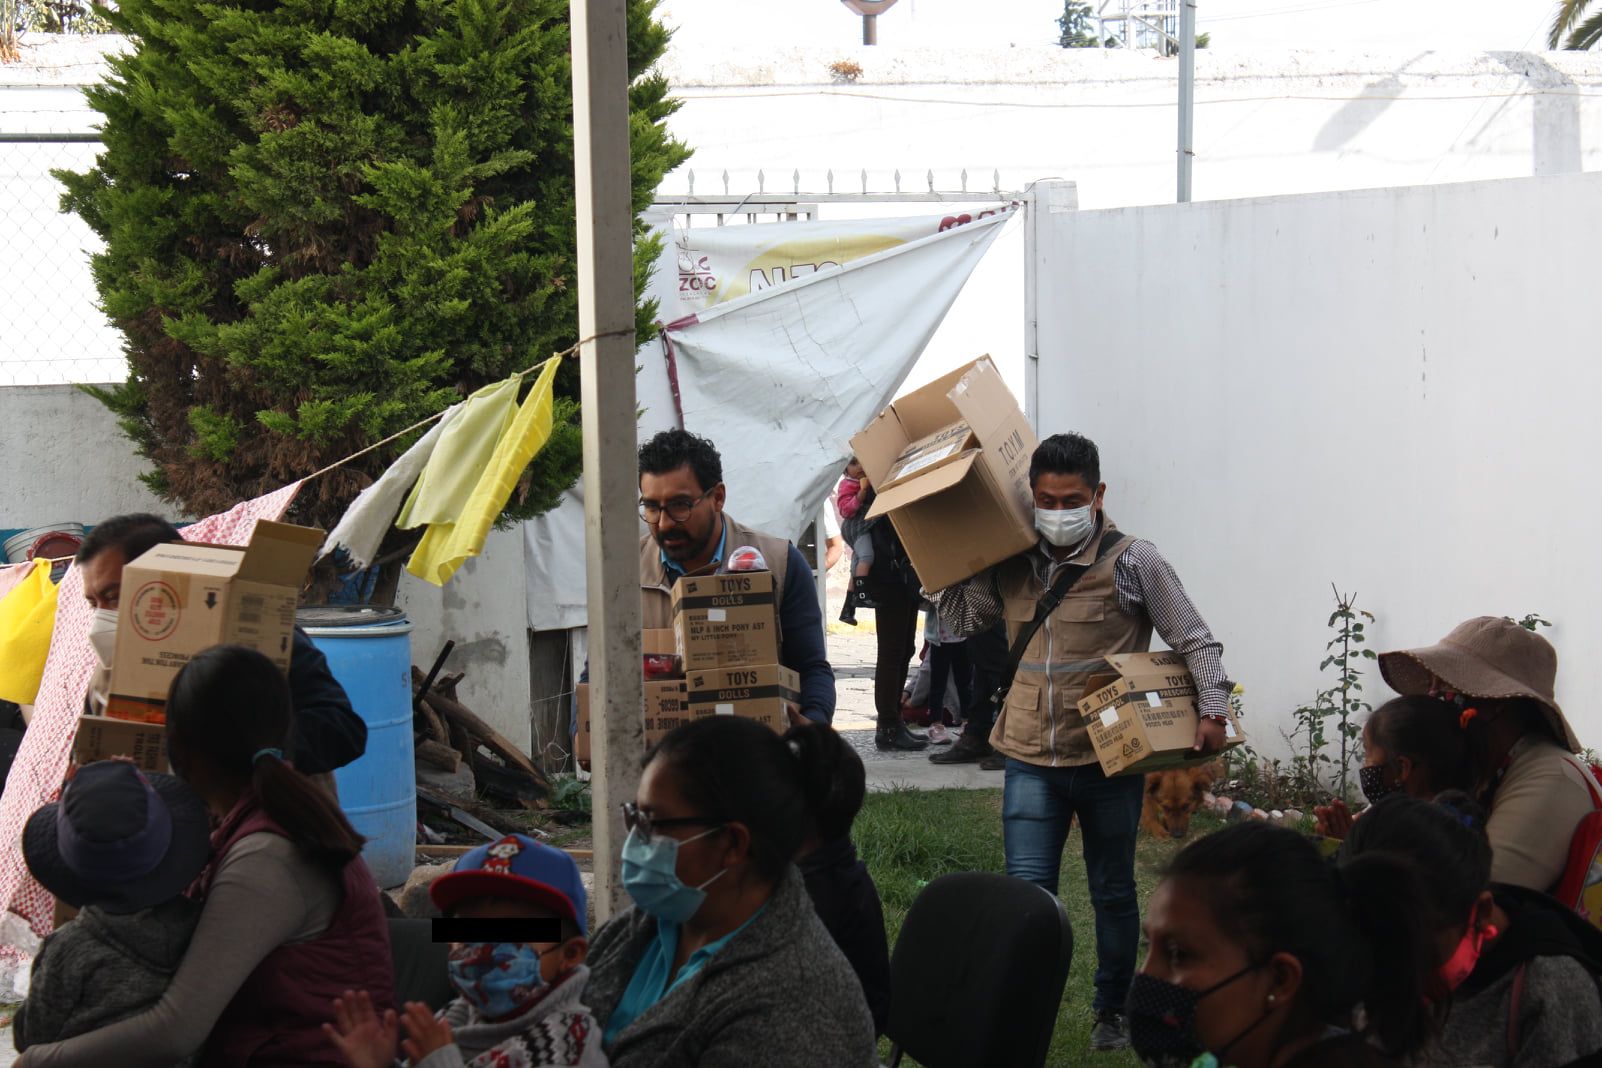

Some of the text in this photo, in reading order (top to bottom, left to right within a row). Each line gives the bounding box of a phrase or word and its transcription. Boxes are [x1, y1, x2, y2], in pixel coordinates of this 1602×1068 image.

[720, 577, 751, 593] TOYS
[712, 596, 744, 606] DOLLS
[727, 671, 758, 686] TOYS
[1165, 675, 1191, 687] TOYS
[719, 689, 750, 700] DOLLS
[1096, 685, 1119, 704] TOYS
